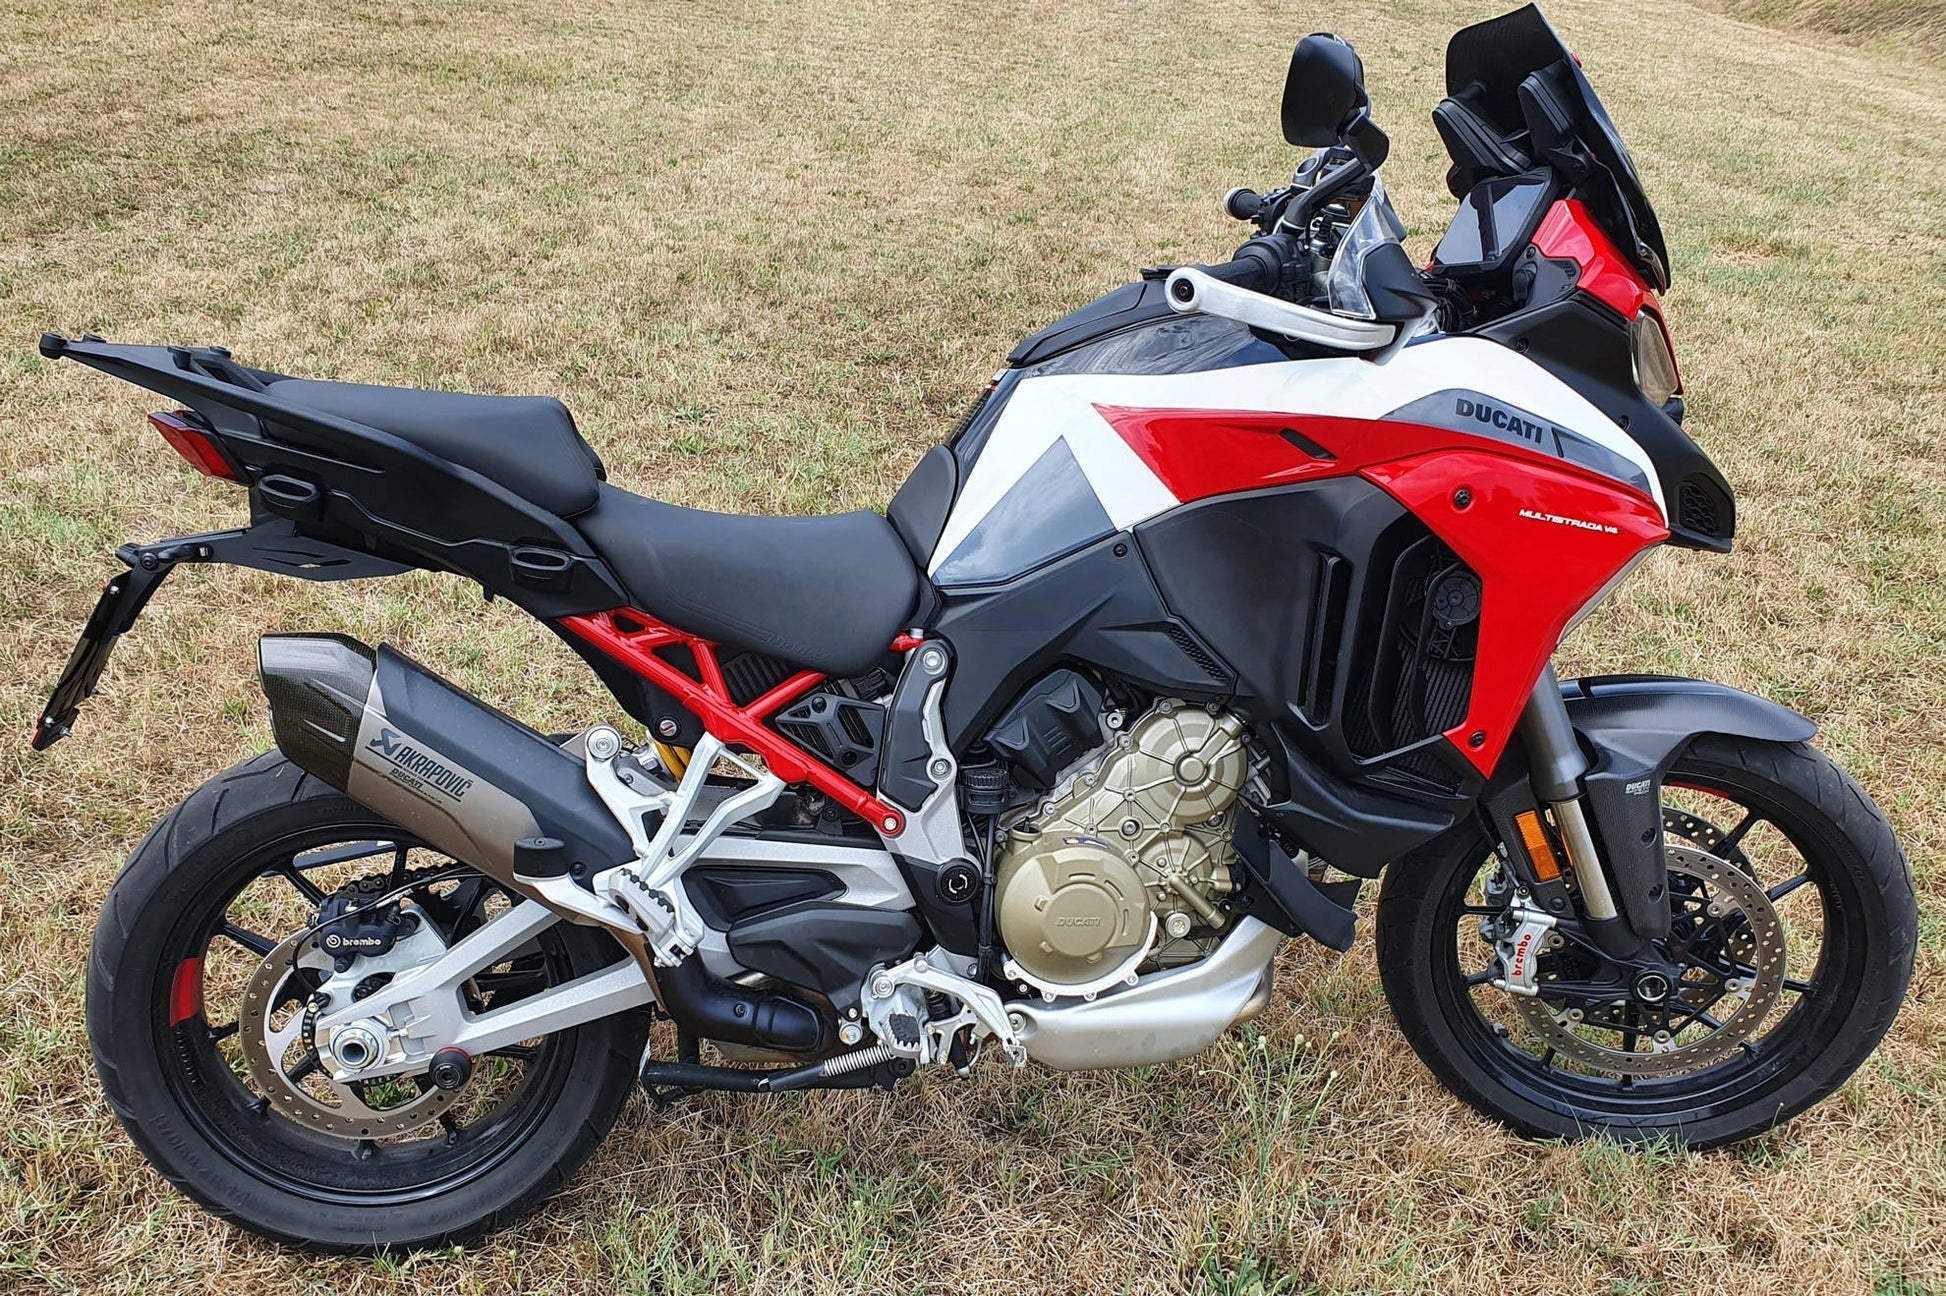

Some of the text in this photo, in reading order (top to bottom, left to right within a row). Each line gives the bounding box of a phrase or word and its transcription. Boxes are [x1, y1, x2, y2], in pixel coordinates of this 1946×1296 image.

[1456, 398, 1542, 443] DUCATI
[1519, 509, 1602, 532] MULTISTRADA
[389, 768, 424, 789] DUCATI
[1057, 917, 1101, 927] DUCATI
[342, 937, 381, 946] brembo
[1511, 934, 1531, 977] brembo
